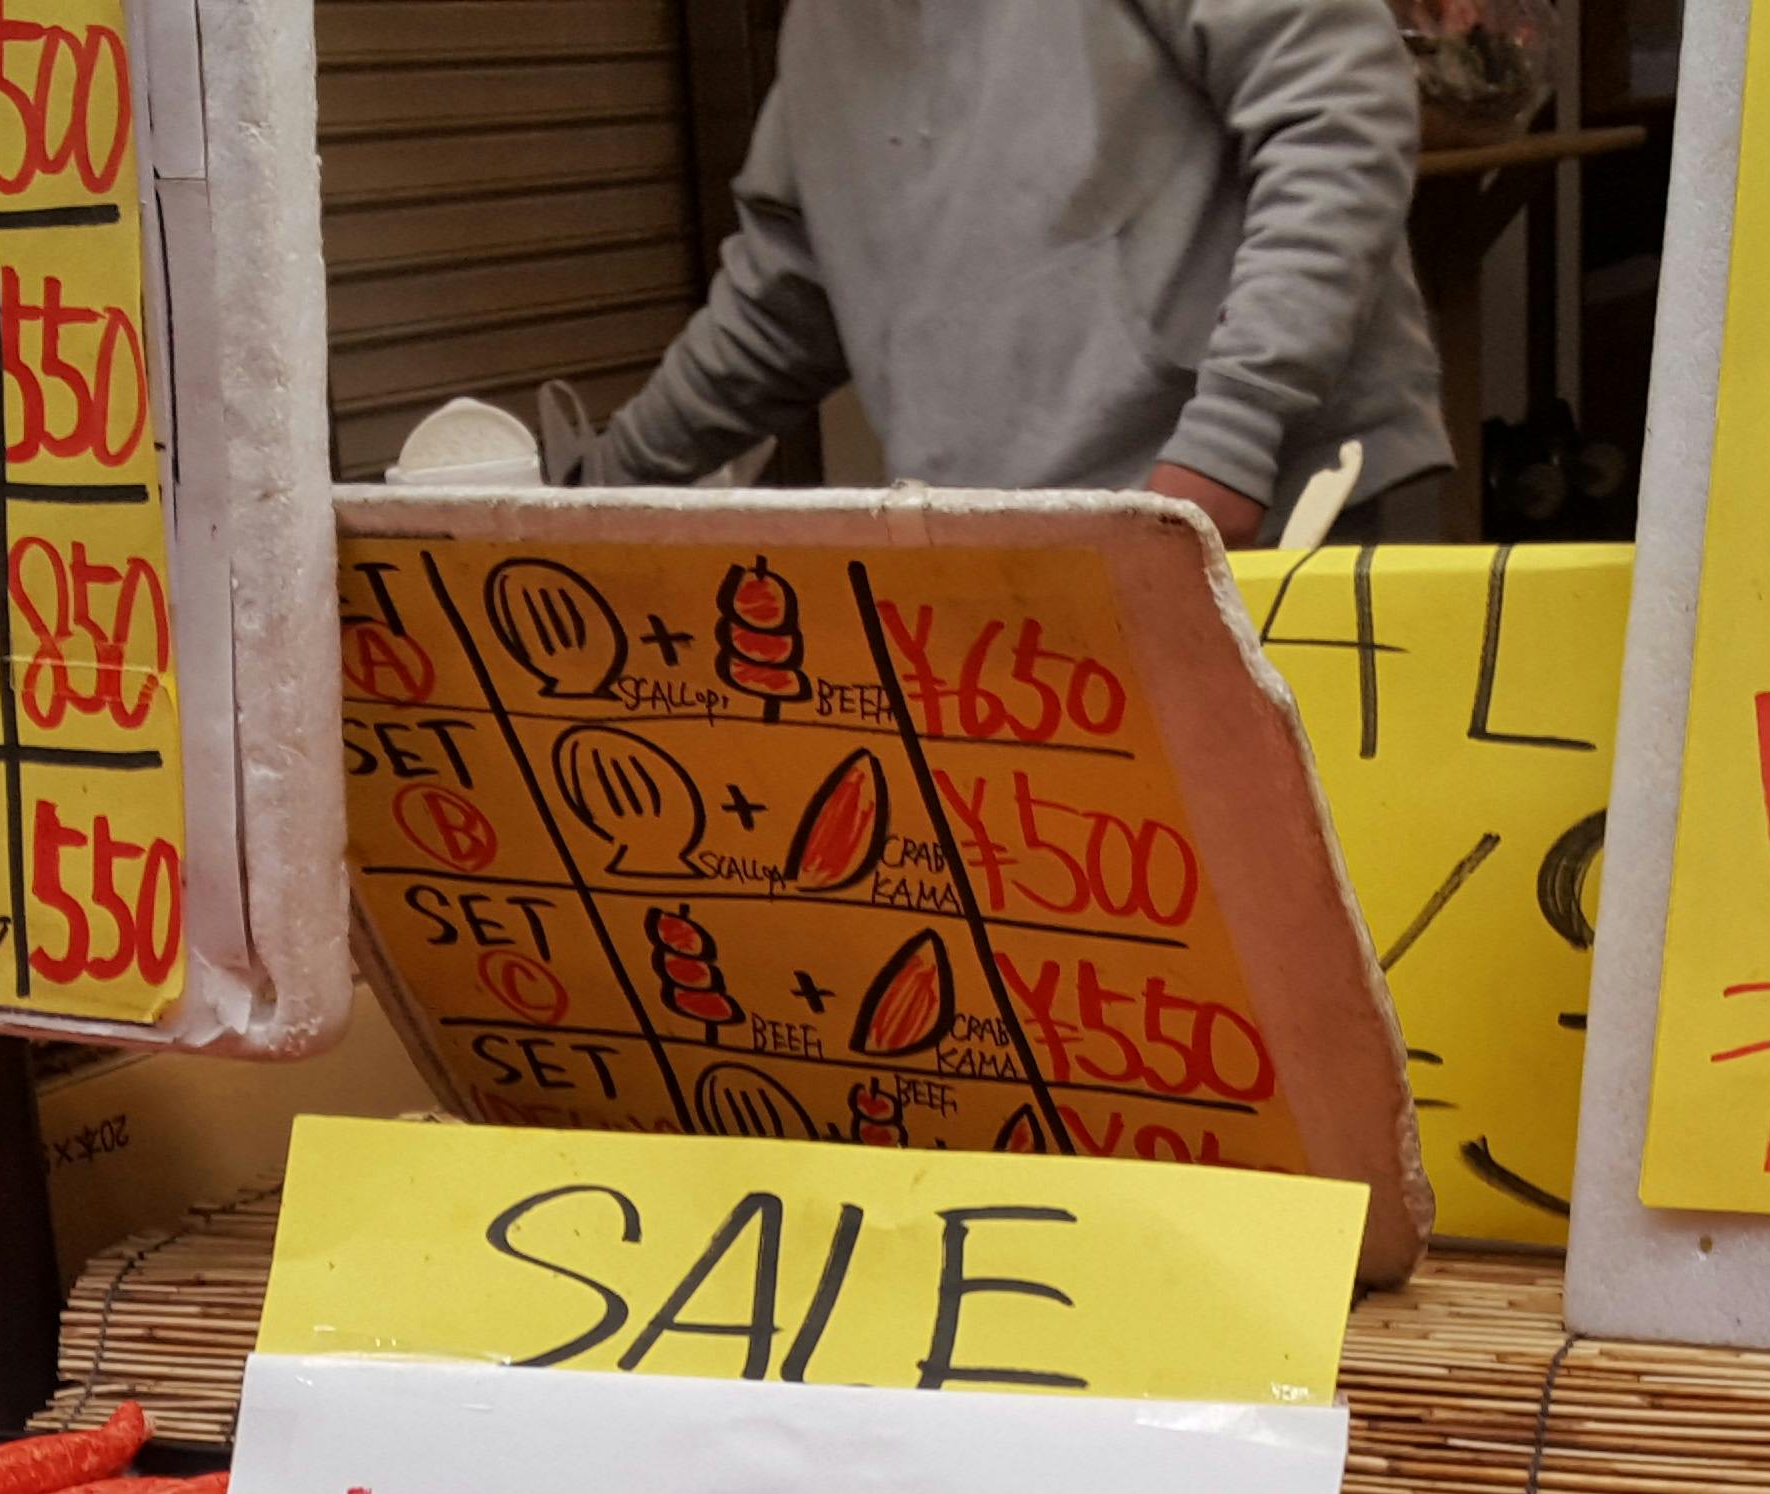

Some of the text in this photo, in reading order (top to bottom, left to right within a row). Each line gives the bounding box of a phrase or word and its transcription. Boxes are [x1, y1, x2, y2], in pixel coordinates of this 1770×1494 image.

[1, 266, 149, 467] 550
[6, 533, 170, 730] 850
[875, 599, 1127, 744] ¥650
[343, 717, 478, 790] SET
[29, 800, 185, 985] 550
[872, 871, 964, 915] KAMA
[931, 769, 1200, 928] ¥500
[404, 884, 558, 963] SET
[471, 1032, 622, 1101] SET
[936, 1045, 1020, 1083] KAMA
[993, 951, 1277, 1102] ¥550
[484, 1183, 1089, 1390] SALE
